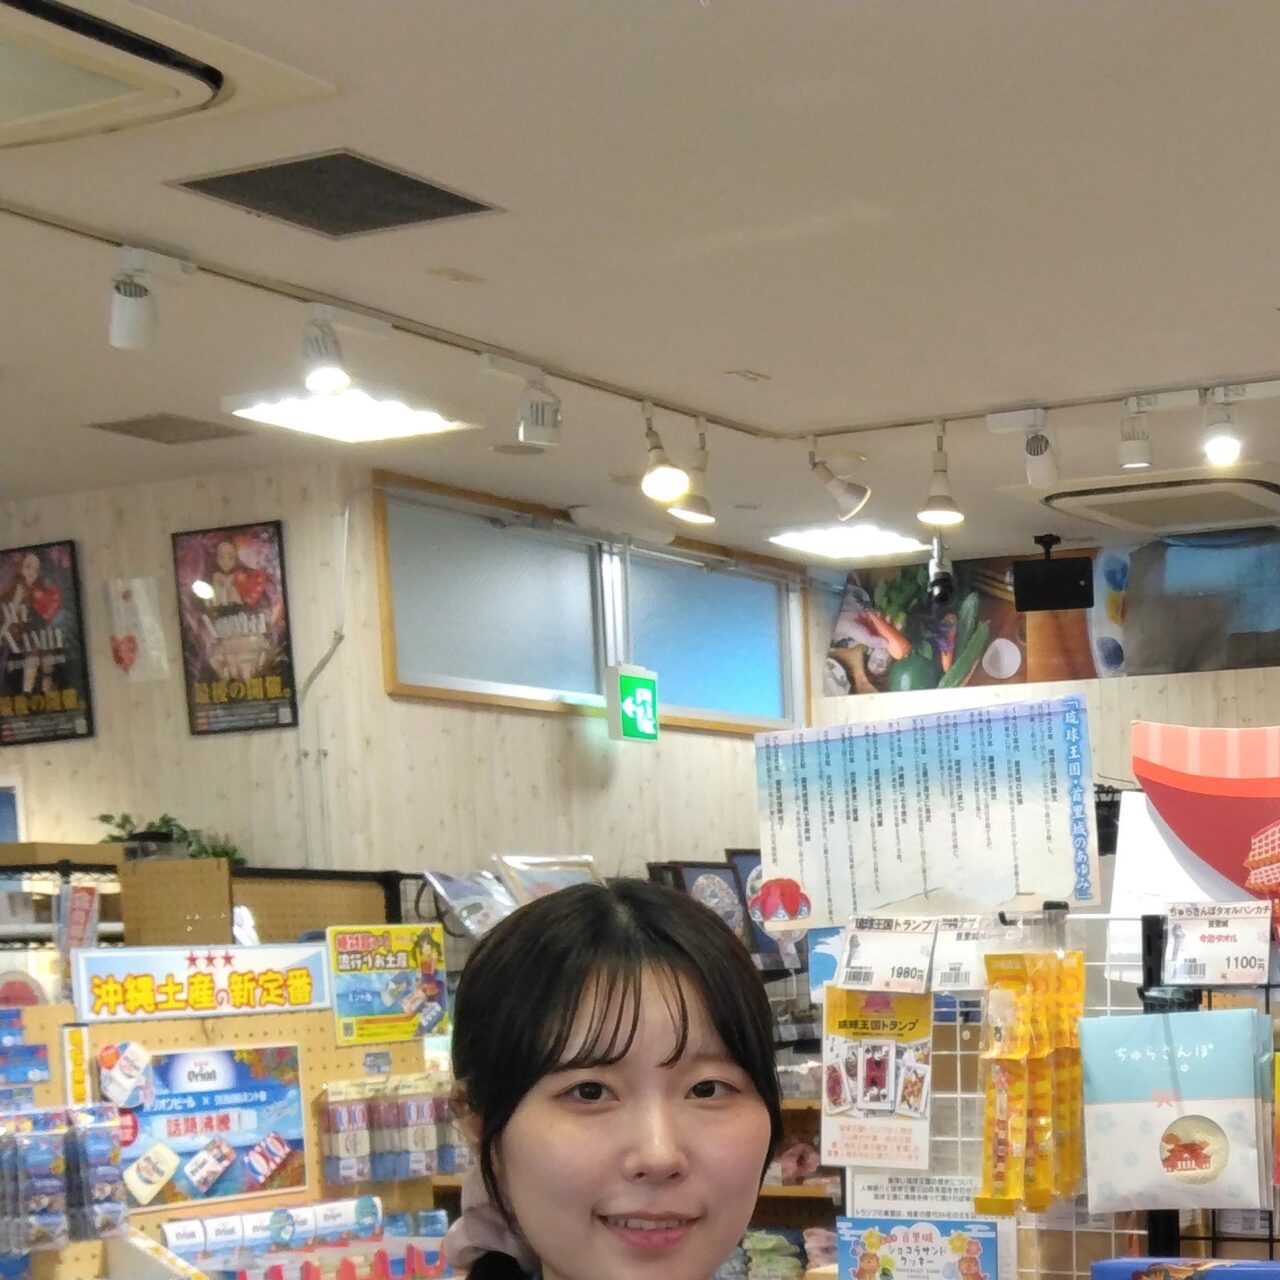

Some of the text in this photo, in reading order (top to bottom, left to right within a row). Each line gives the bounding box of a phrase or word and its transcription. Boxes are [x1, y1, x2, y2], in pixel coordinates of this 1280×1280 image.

[1169, 906, 1271, 917] ちゅらさんぽタオルハンカチ
[1199, 934, 1237, 943] 今治タオル
[91, 968, 313, 1014] 沖縄土産の新定番
[838, 1018, 919, 1032] 琉球王国トランプ
[1115, 1043, 1214, 1061] ちゅらさんぽ
[888, 1245, 947, 1256] ショコラサンド
